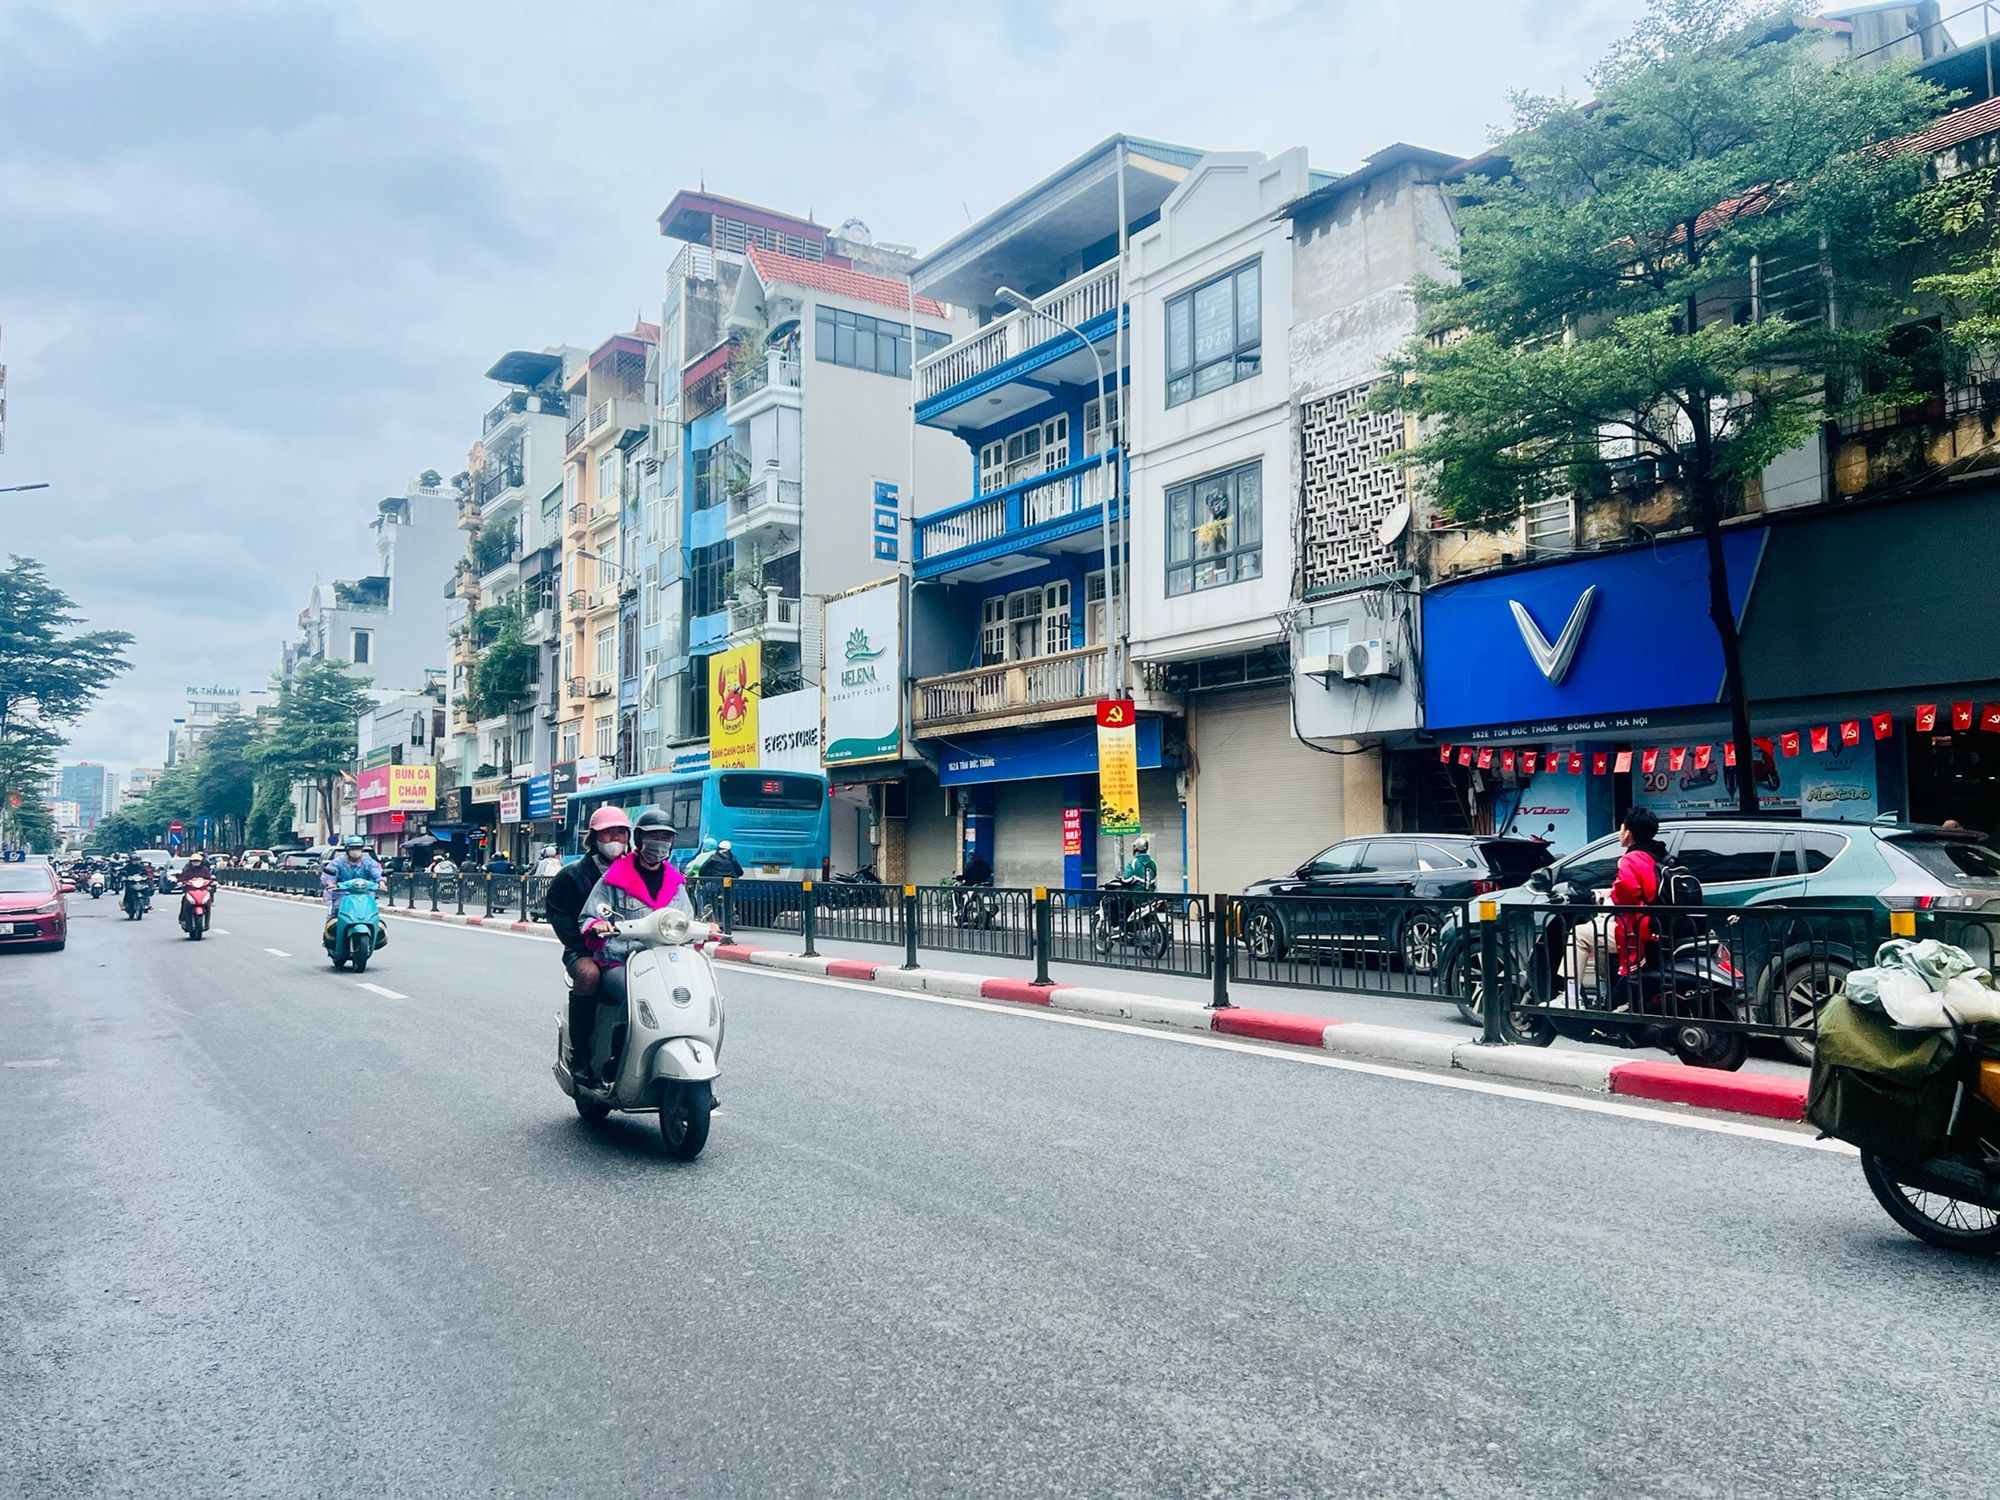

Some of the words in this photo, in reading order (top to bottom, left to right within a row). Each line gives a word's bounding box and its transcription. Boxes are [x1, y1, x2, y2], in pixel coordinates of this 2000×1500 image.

[841, 665, 877, 687] HELENA
[186, 687, 198, 695] PK
[833, 690, 860, 701] BEAUTY
[864, 684, 890, 695] CLINIC
[765, 733, 787, 752] EYES
[788, 728, 818, 749] STORE
